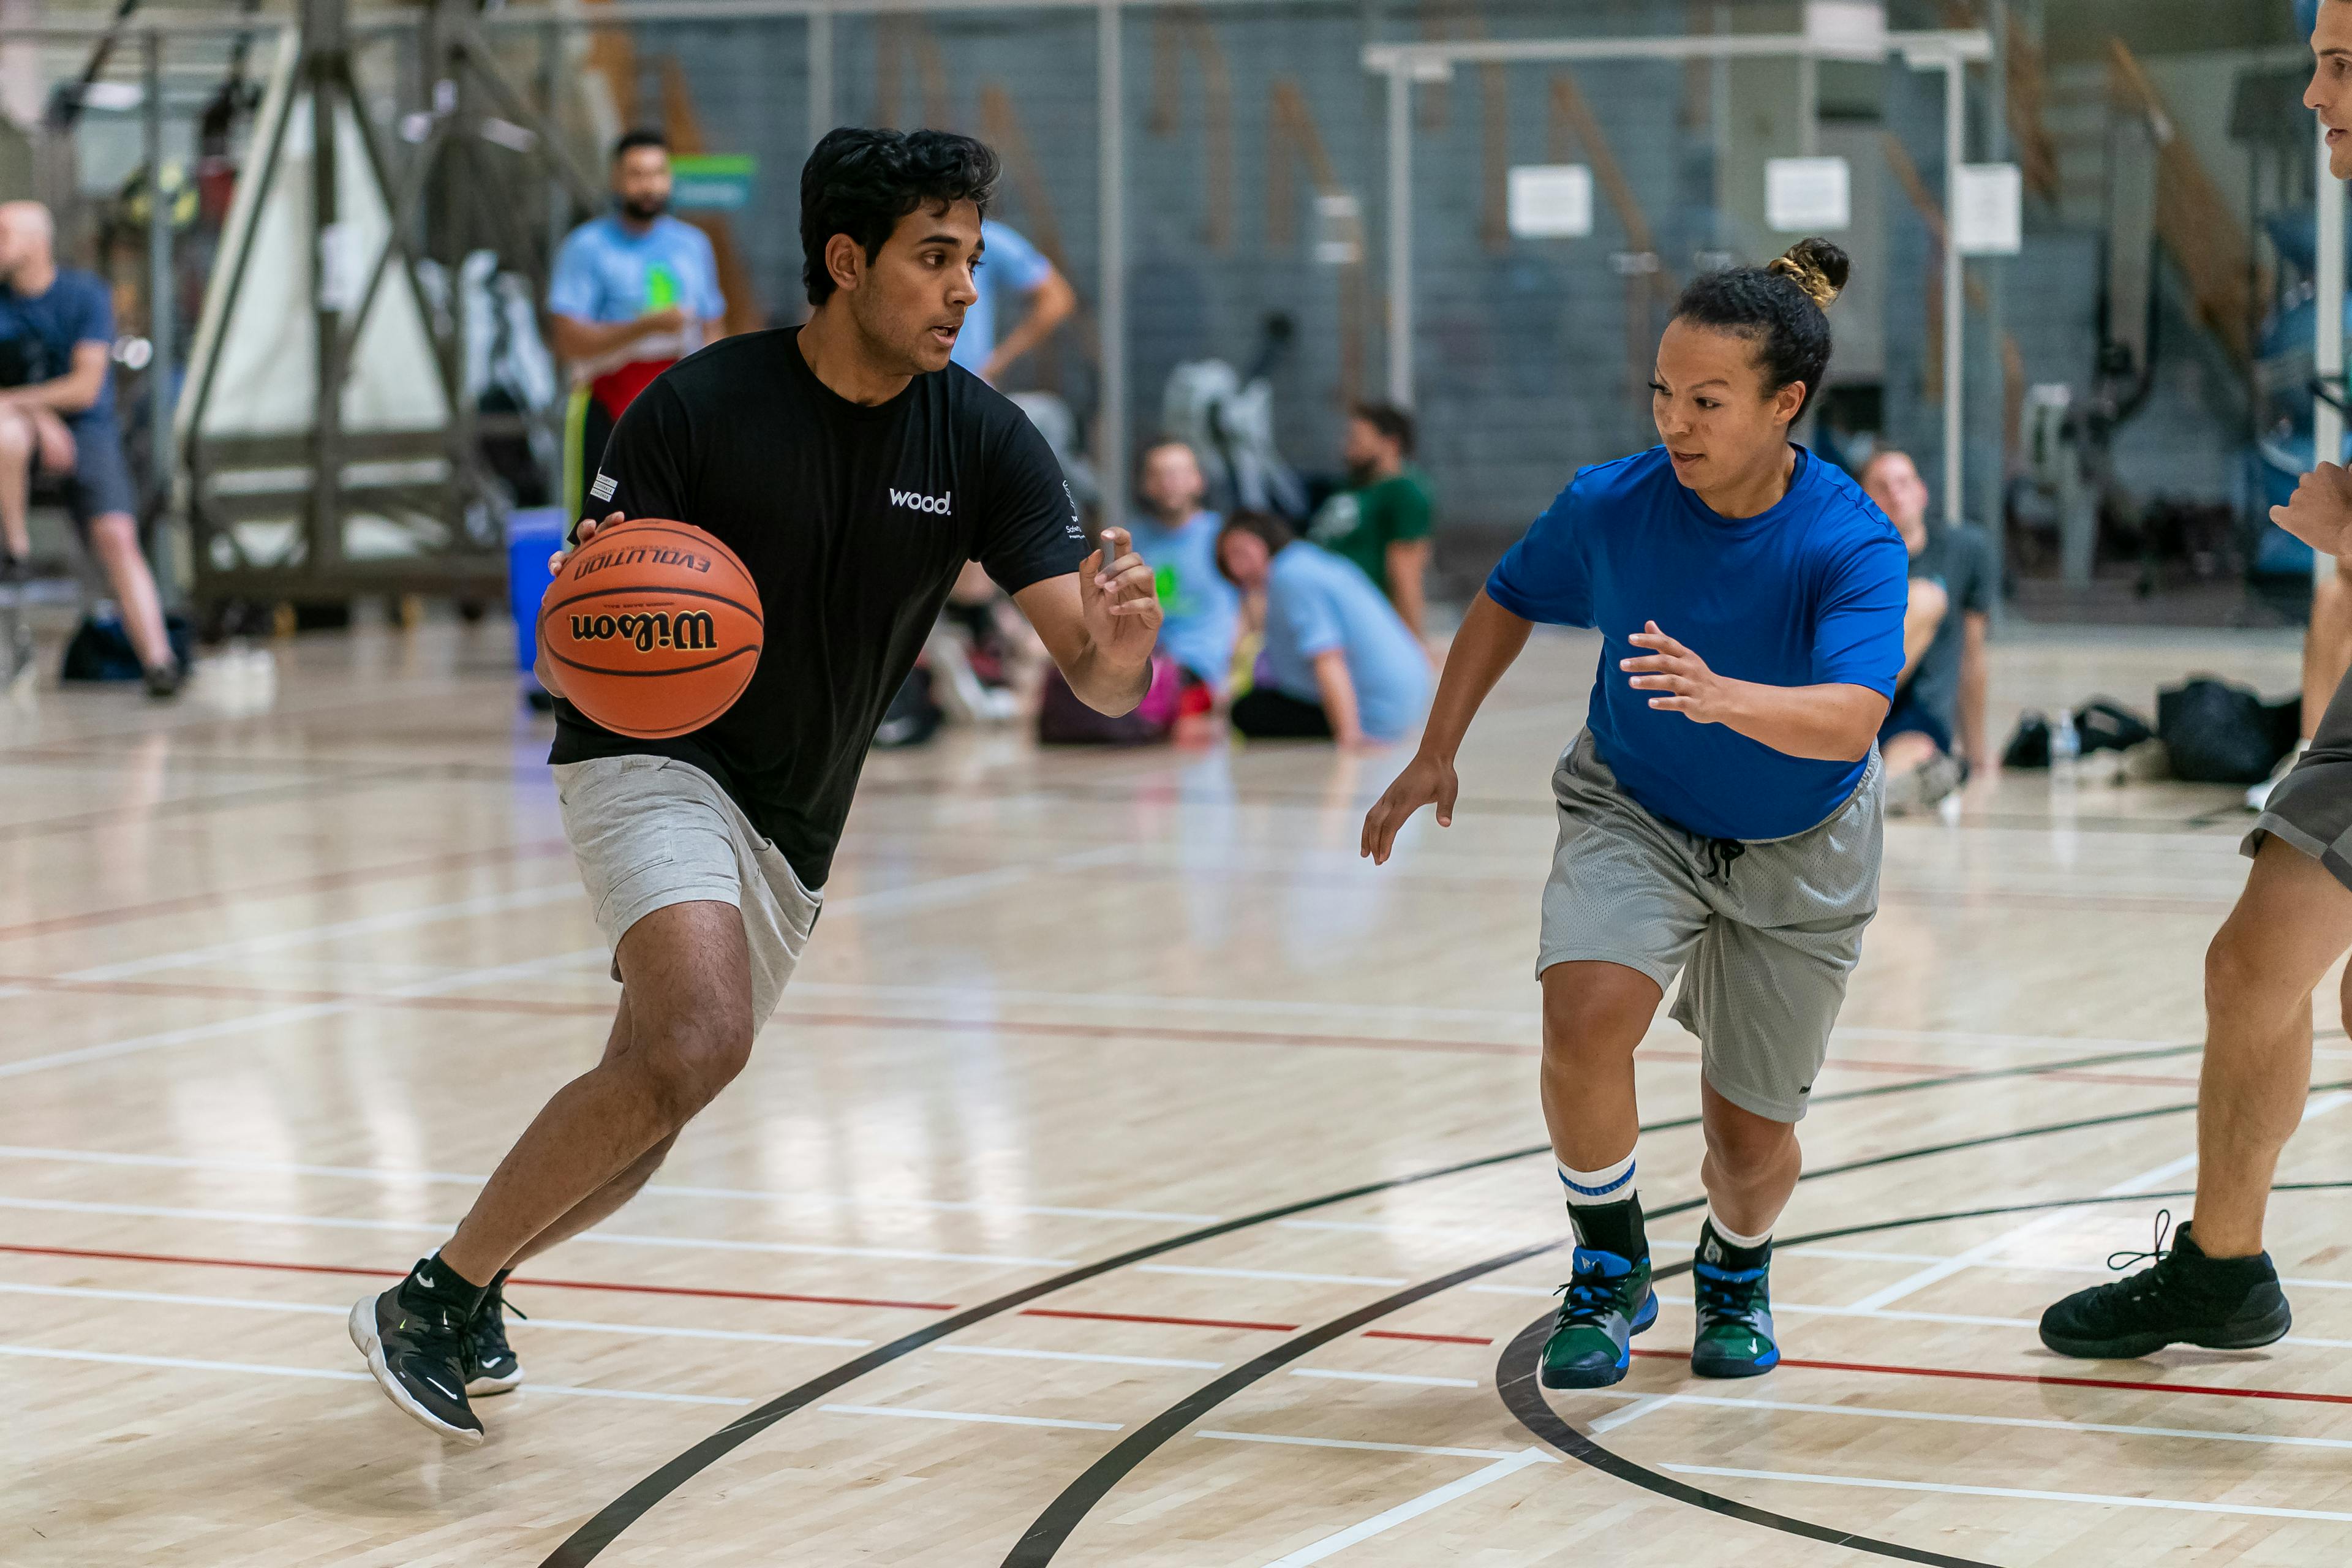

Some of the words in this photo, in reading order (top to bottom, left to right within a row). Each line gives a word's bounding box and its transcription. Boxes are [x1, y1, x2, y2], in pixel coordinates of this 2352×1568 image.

[889, 488, 951, 516] wood.
[574, 549, 711, 581] EVOLUTION
[570, 609, 718, 653] Wilson
